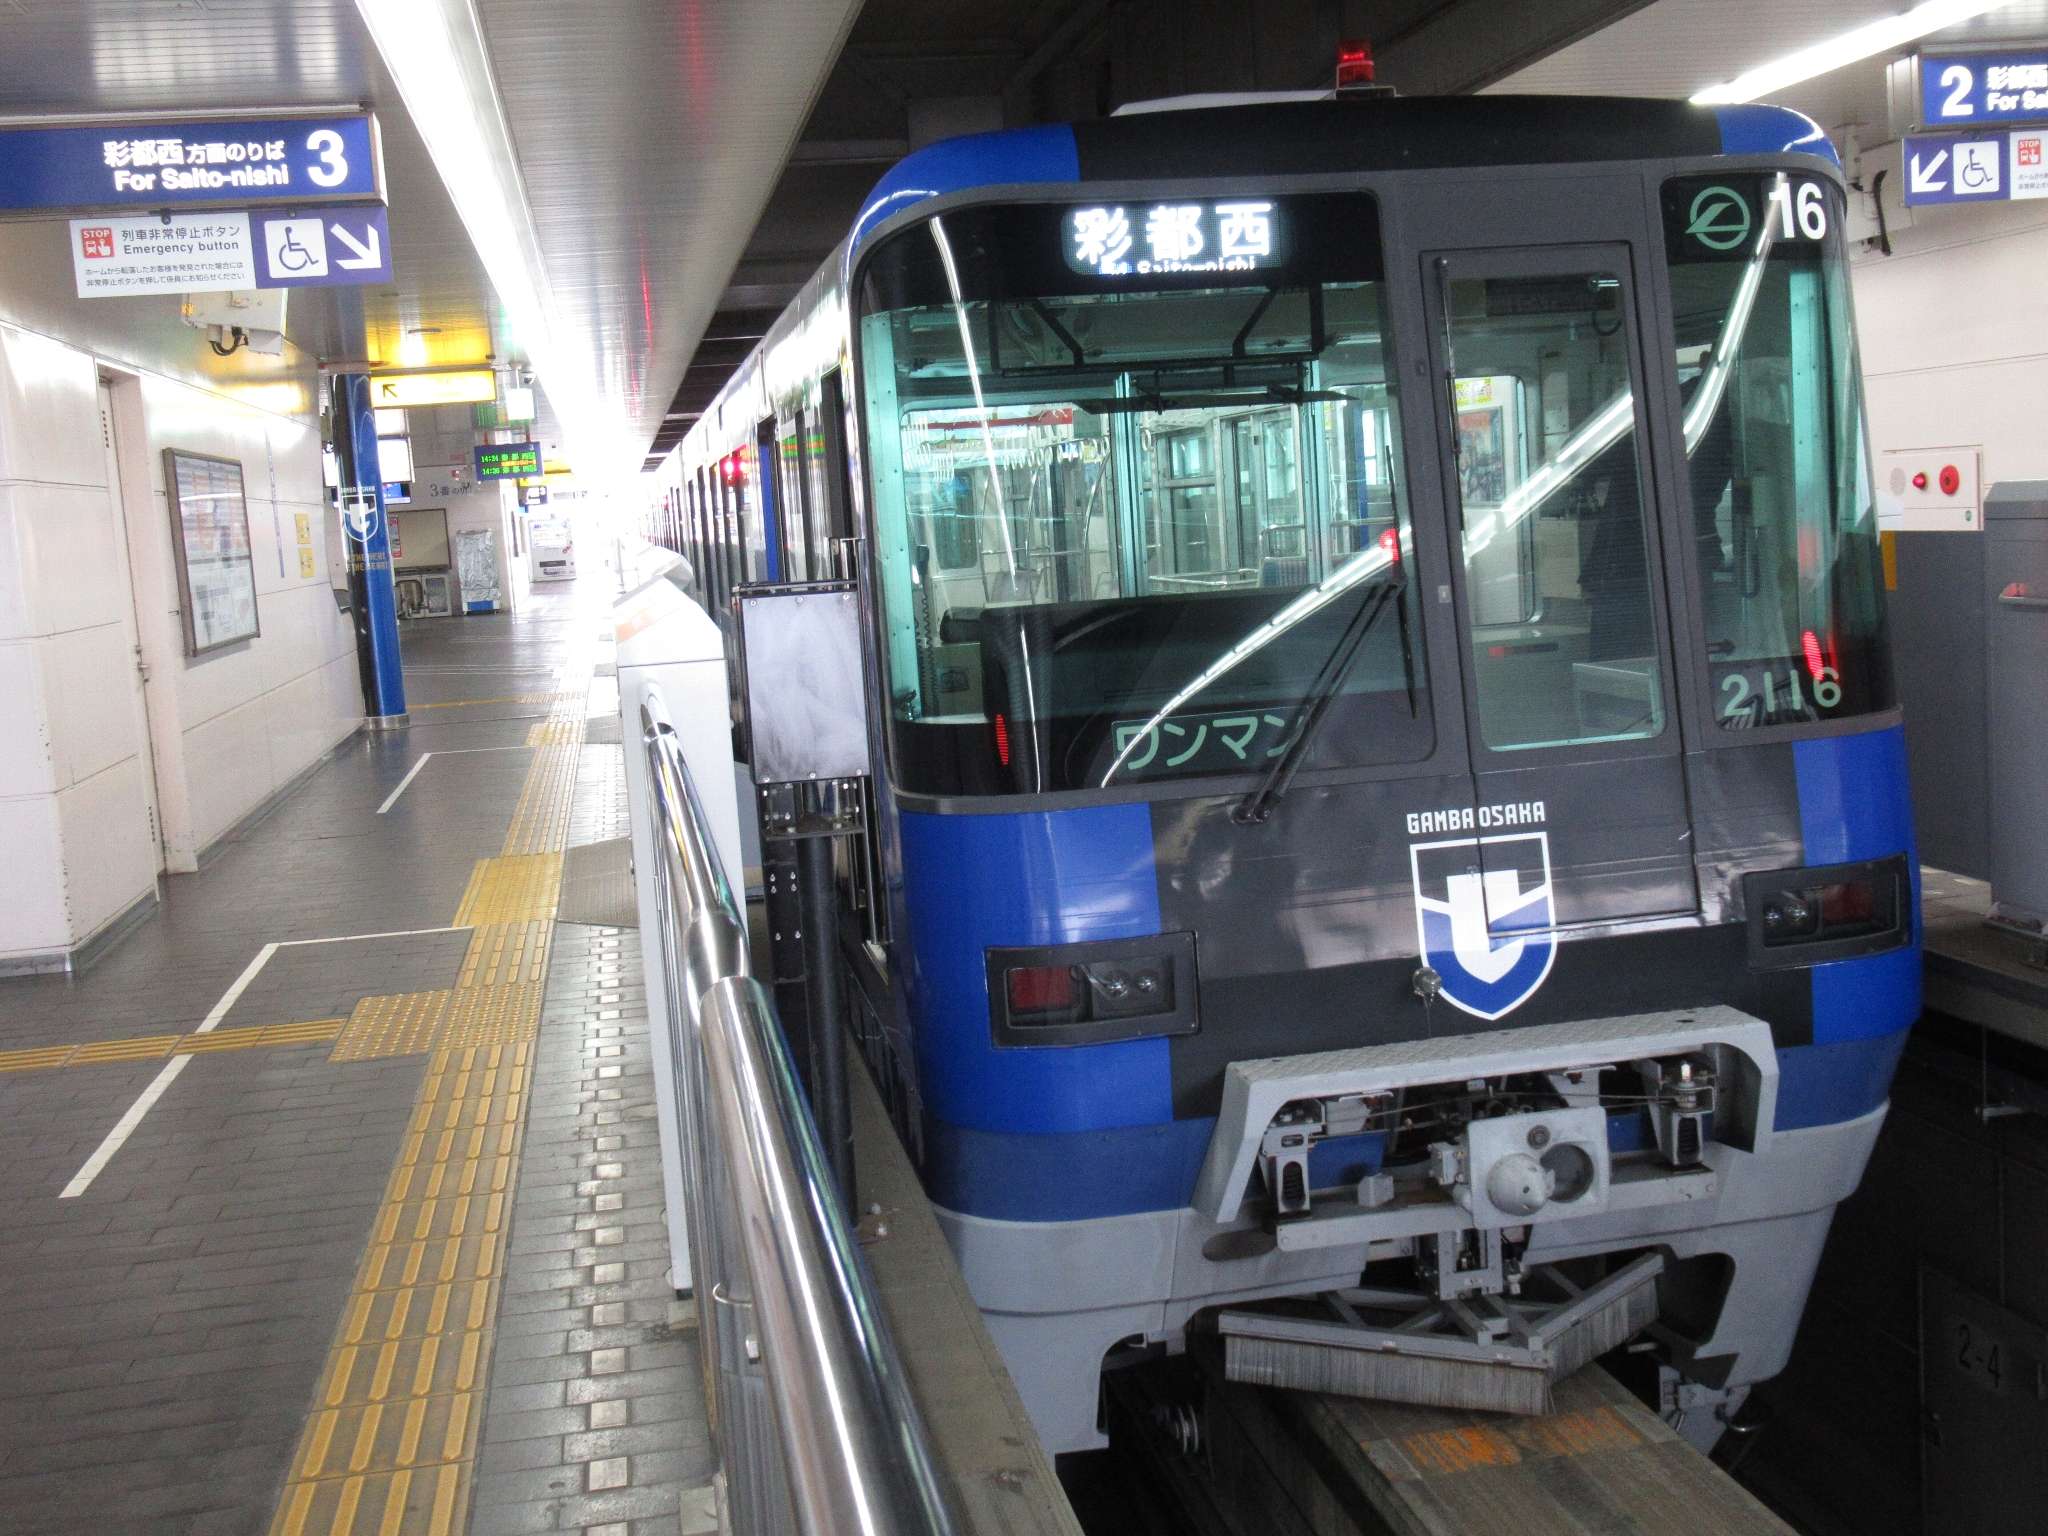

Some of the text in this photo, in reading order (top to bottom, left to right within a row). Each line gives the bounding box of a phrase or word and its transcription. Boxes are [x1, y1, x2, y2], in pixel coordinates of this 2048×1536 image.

[1940, 65, 1973, 117] 2
[1987, 92, 2020, 111] For
[114, 163, 289, 191] For Saito-nishi
[306, 130, 348, 187] 3
[1768, 182, 1826, 240] 16
[82, 229, 110, 239] STOP
[121, 225, 241, 242] 列車非常停止ボタン
[123, 240, 239, 256] Emergency button
[1073, 202, 1275, 265] 彩都西
[1721, 666, 1842, 717] 2116
[1116, 713, 1306, 771] ワンマン
[1406, 801, 1546, 834] GAMBA OSAKA
